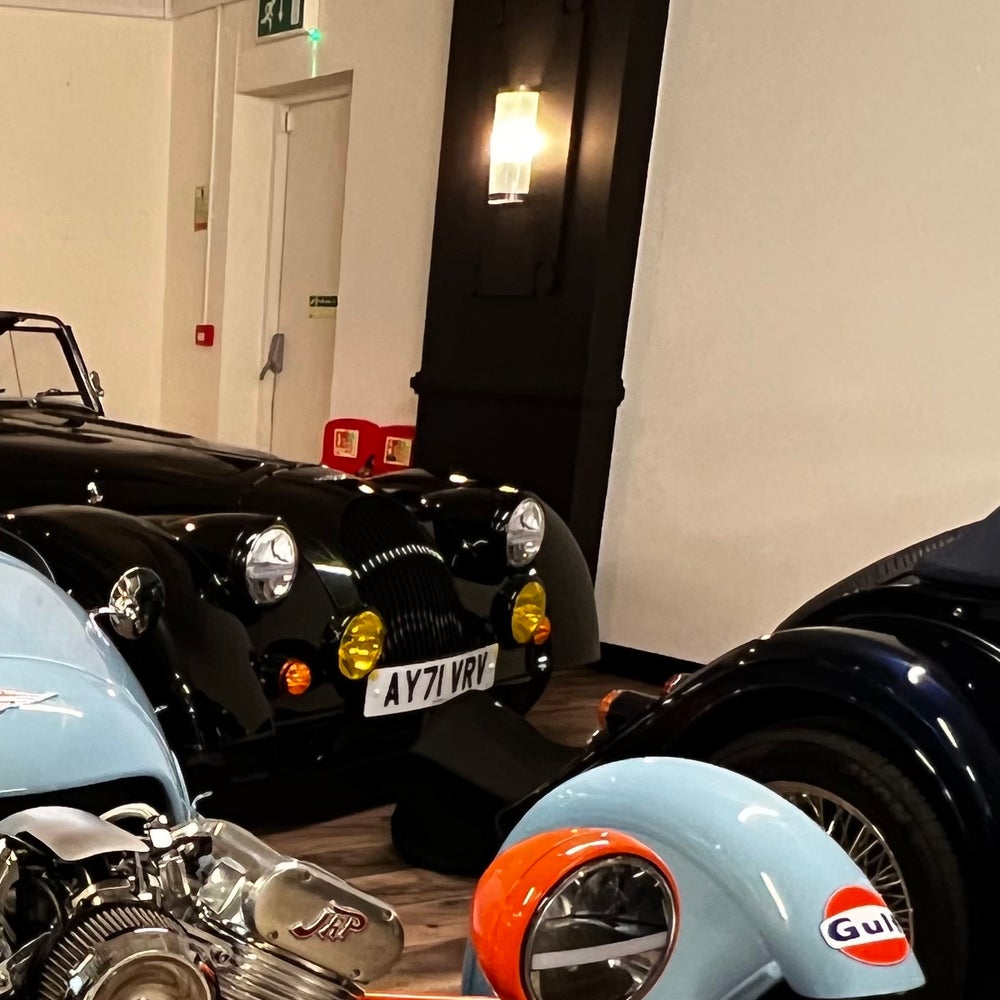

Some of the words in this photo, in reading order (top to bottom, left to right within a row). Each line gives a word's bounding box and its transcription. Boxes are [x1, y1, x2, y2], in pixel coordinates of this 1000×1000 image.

[384, 664, 445, 707] AY71
[451, 652, 488, 694] VRV
[289, 900, 368, 941] JAP
